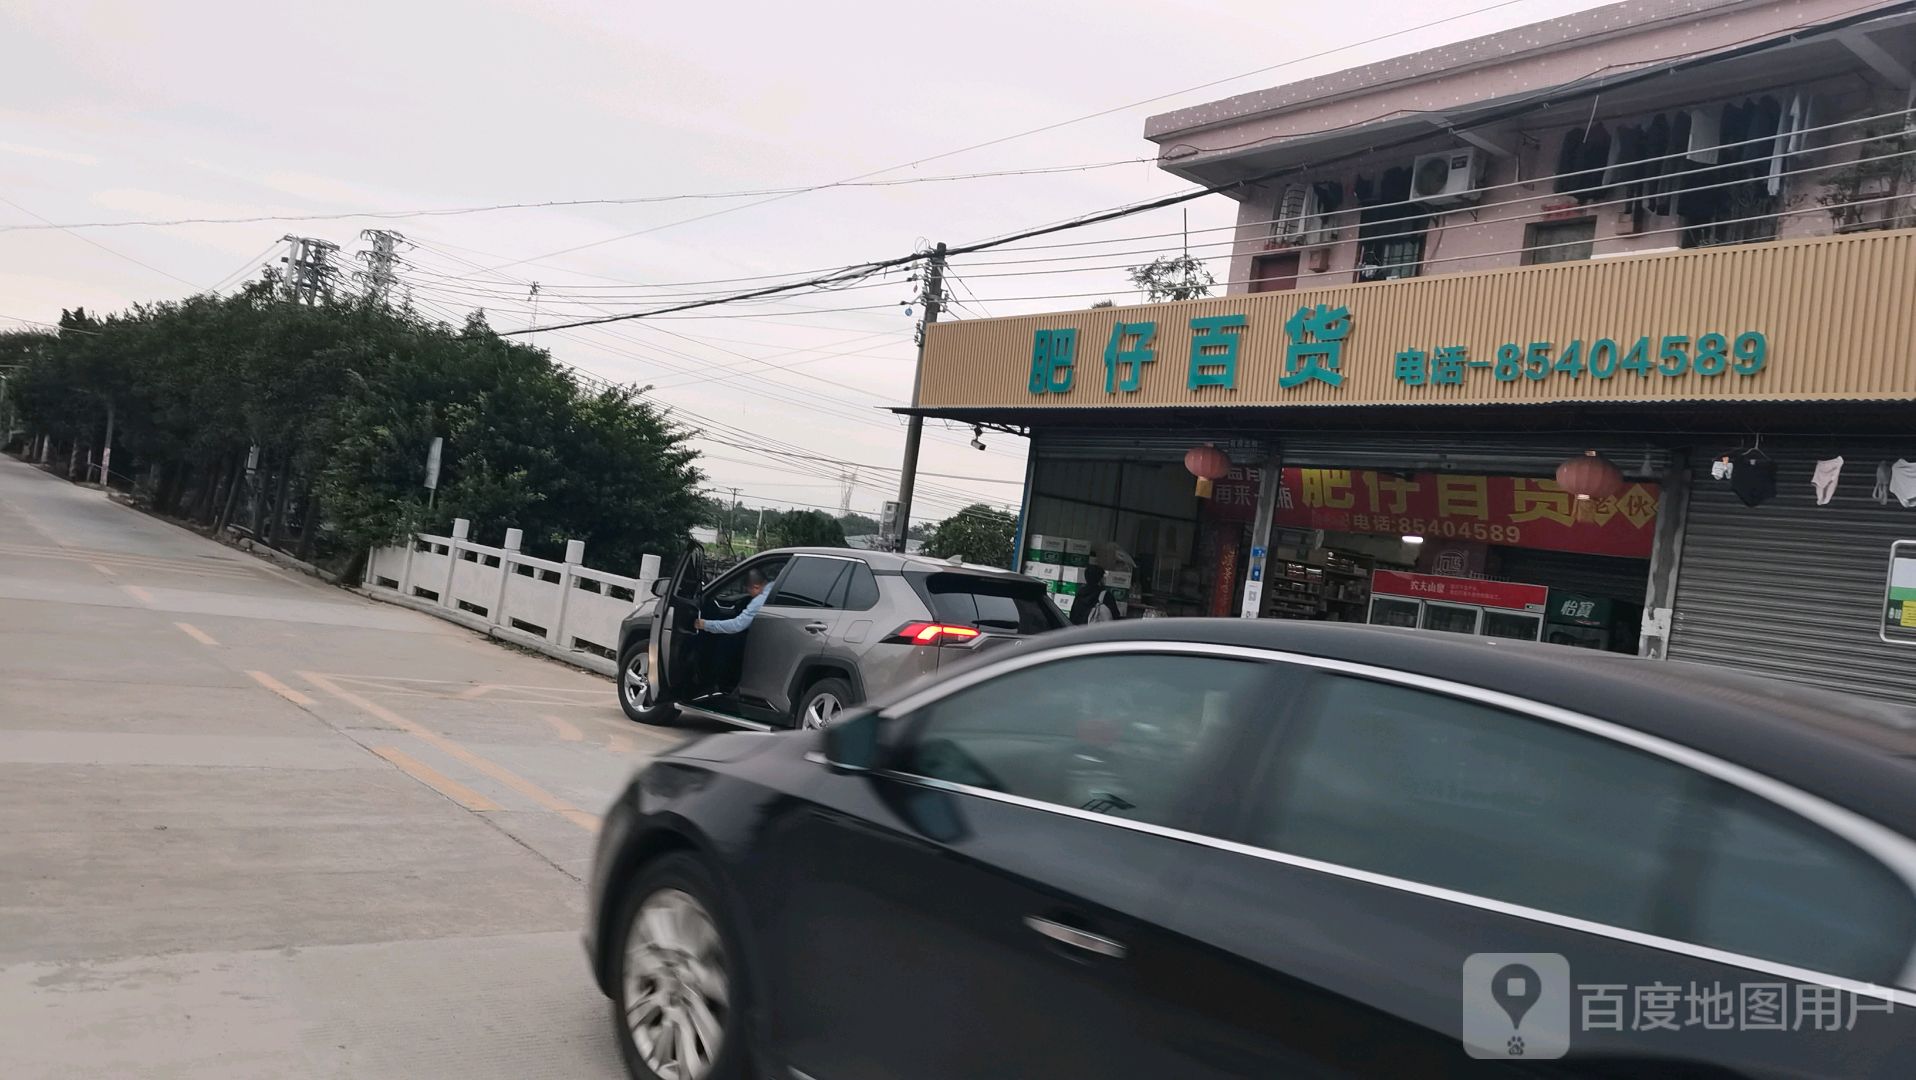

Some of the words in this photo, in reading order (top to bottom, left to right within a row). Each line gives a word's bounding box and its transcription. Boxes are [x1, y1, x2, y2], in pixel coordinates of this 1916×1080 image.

[1029, 303, 1353, 394] 肥仔百货
[1394, 331, 1769, 386] 电话-85404589
[1353, 514, 1521, 543] 电话:85404589
